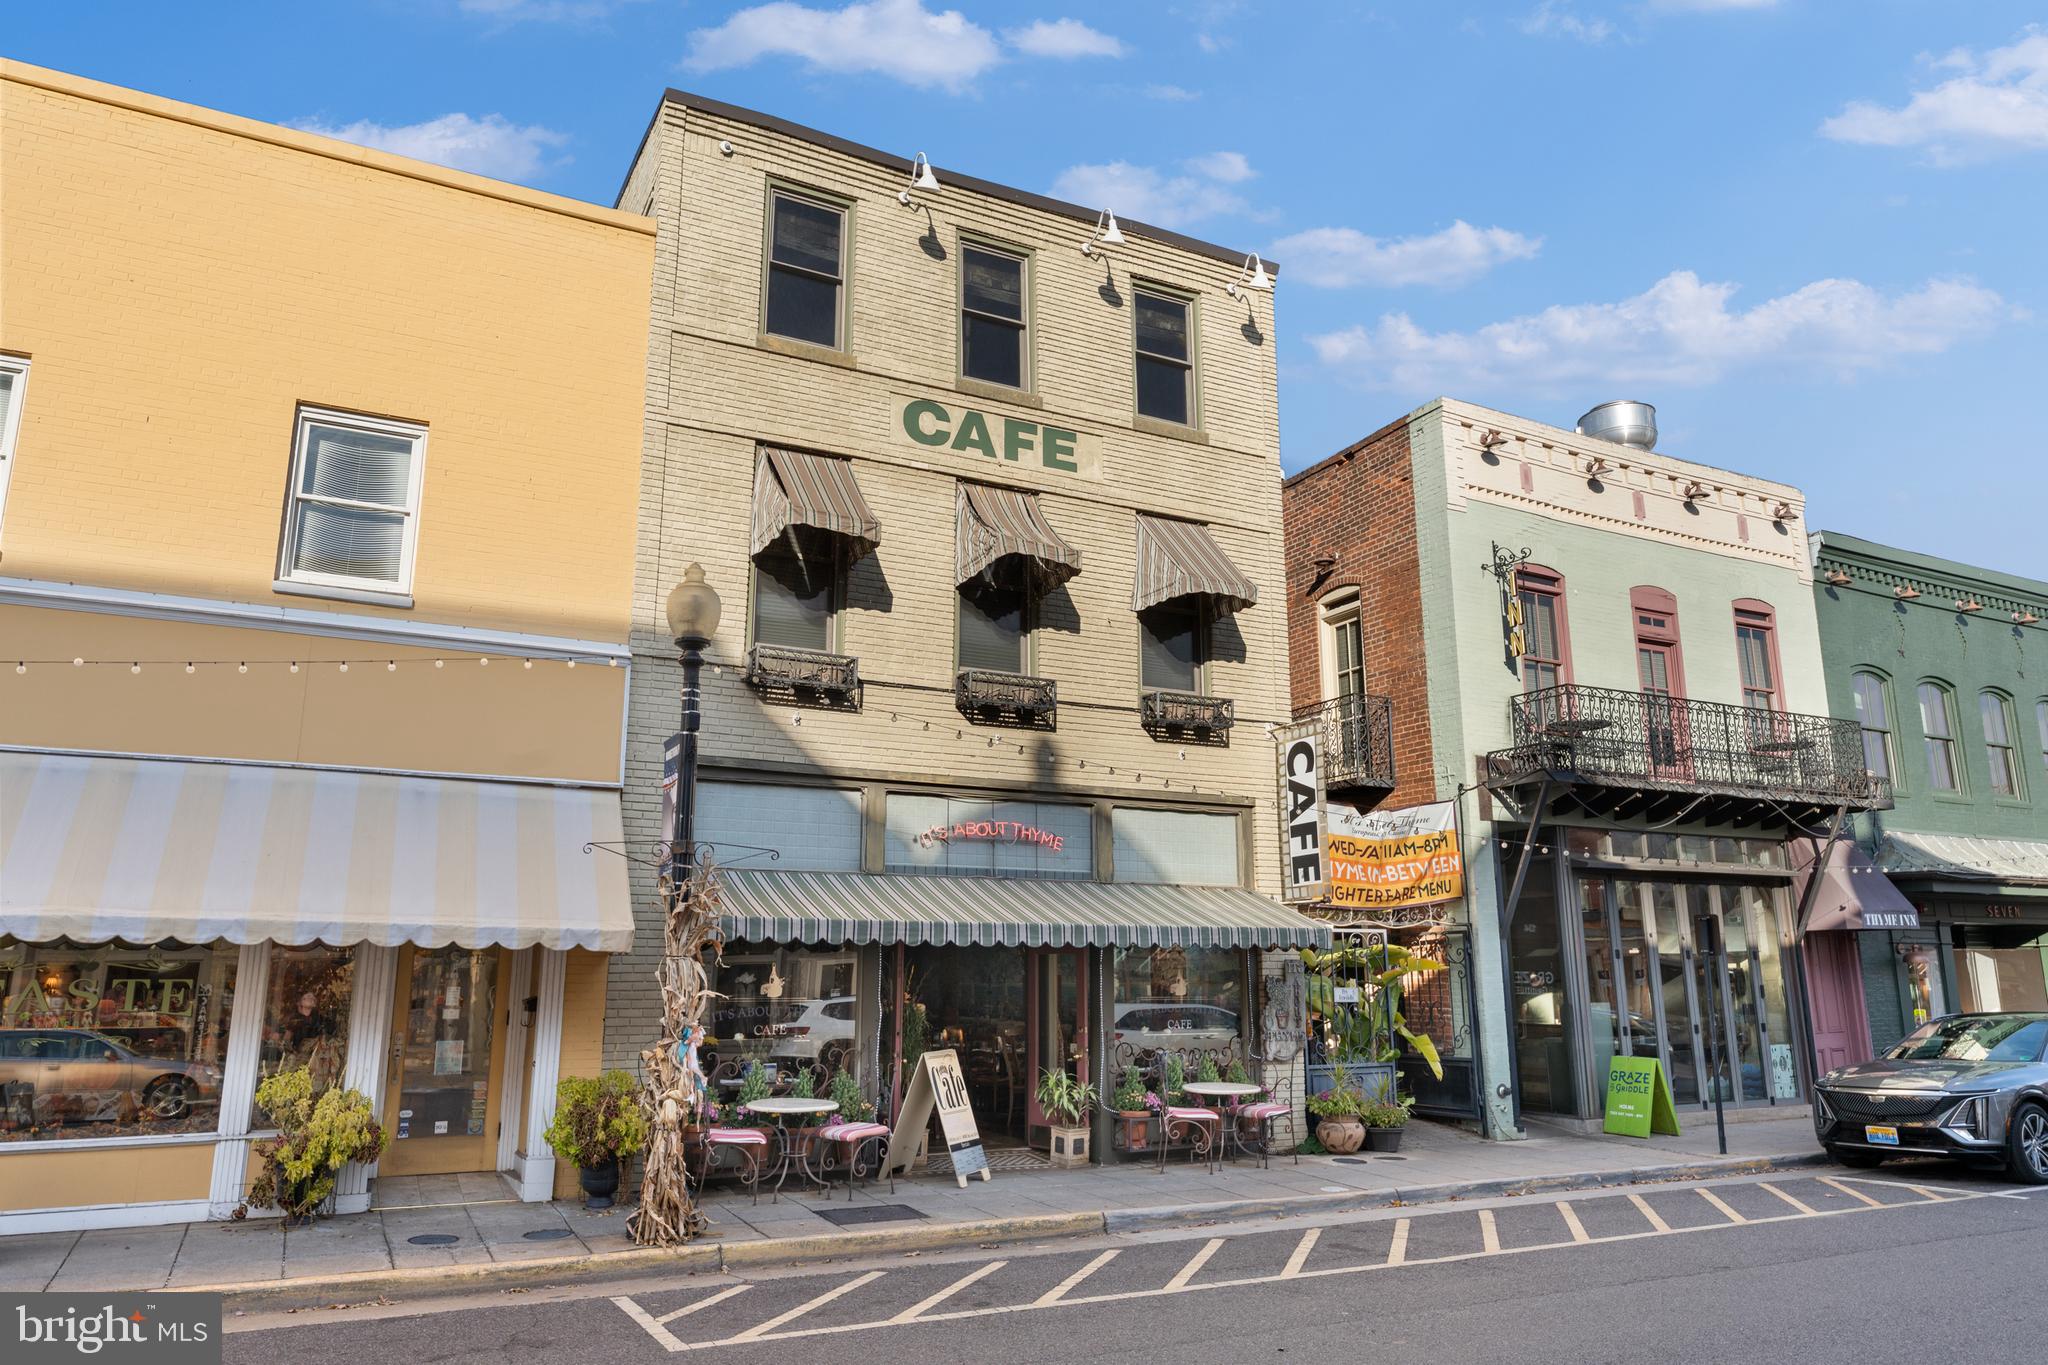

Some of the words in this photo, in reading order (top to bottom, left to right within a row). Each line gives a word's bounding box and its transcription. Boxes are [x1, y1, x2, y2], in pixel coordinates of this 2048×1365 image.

[903, 400, 1078, 473] CAFE
[1507, 571, 1527, 657] INN
[1287, 741, 1322, 885] CAFE
[953, 821, 1008, 837] ABOUT
[1012, 822, 1064, 851] THYME
[1330, 860, 1366, 882] YME
[1331, 885, 1385, 902] IGHTER
[1417, 879, 1452, 898] MENU
[1864, 913, 1898, 927] THYME
[1900, 913, 1917, 926] INN
[1987, 904, 2022, 919] SEVEN
[753, 1024, 787, 1036] CAFE
[1167, 1019, 1192, 1030] CAFE
[1610, 1070, 1650, 1084] GRAZE
